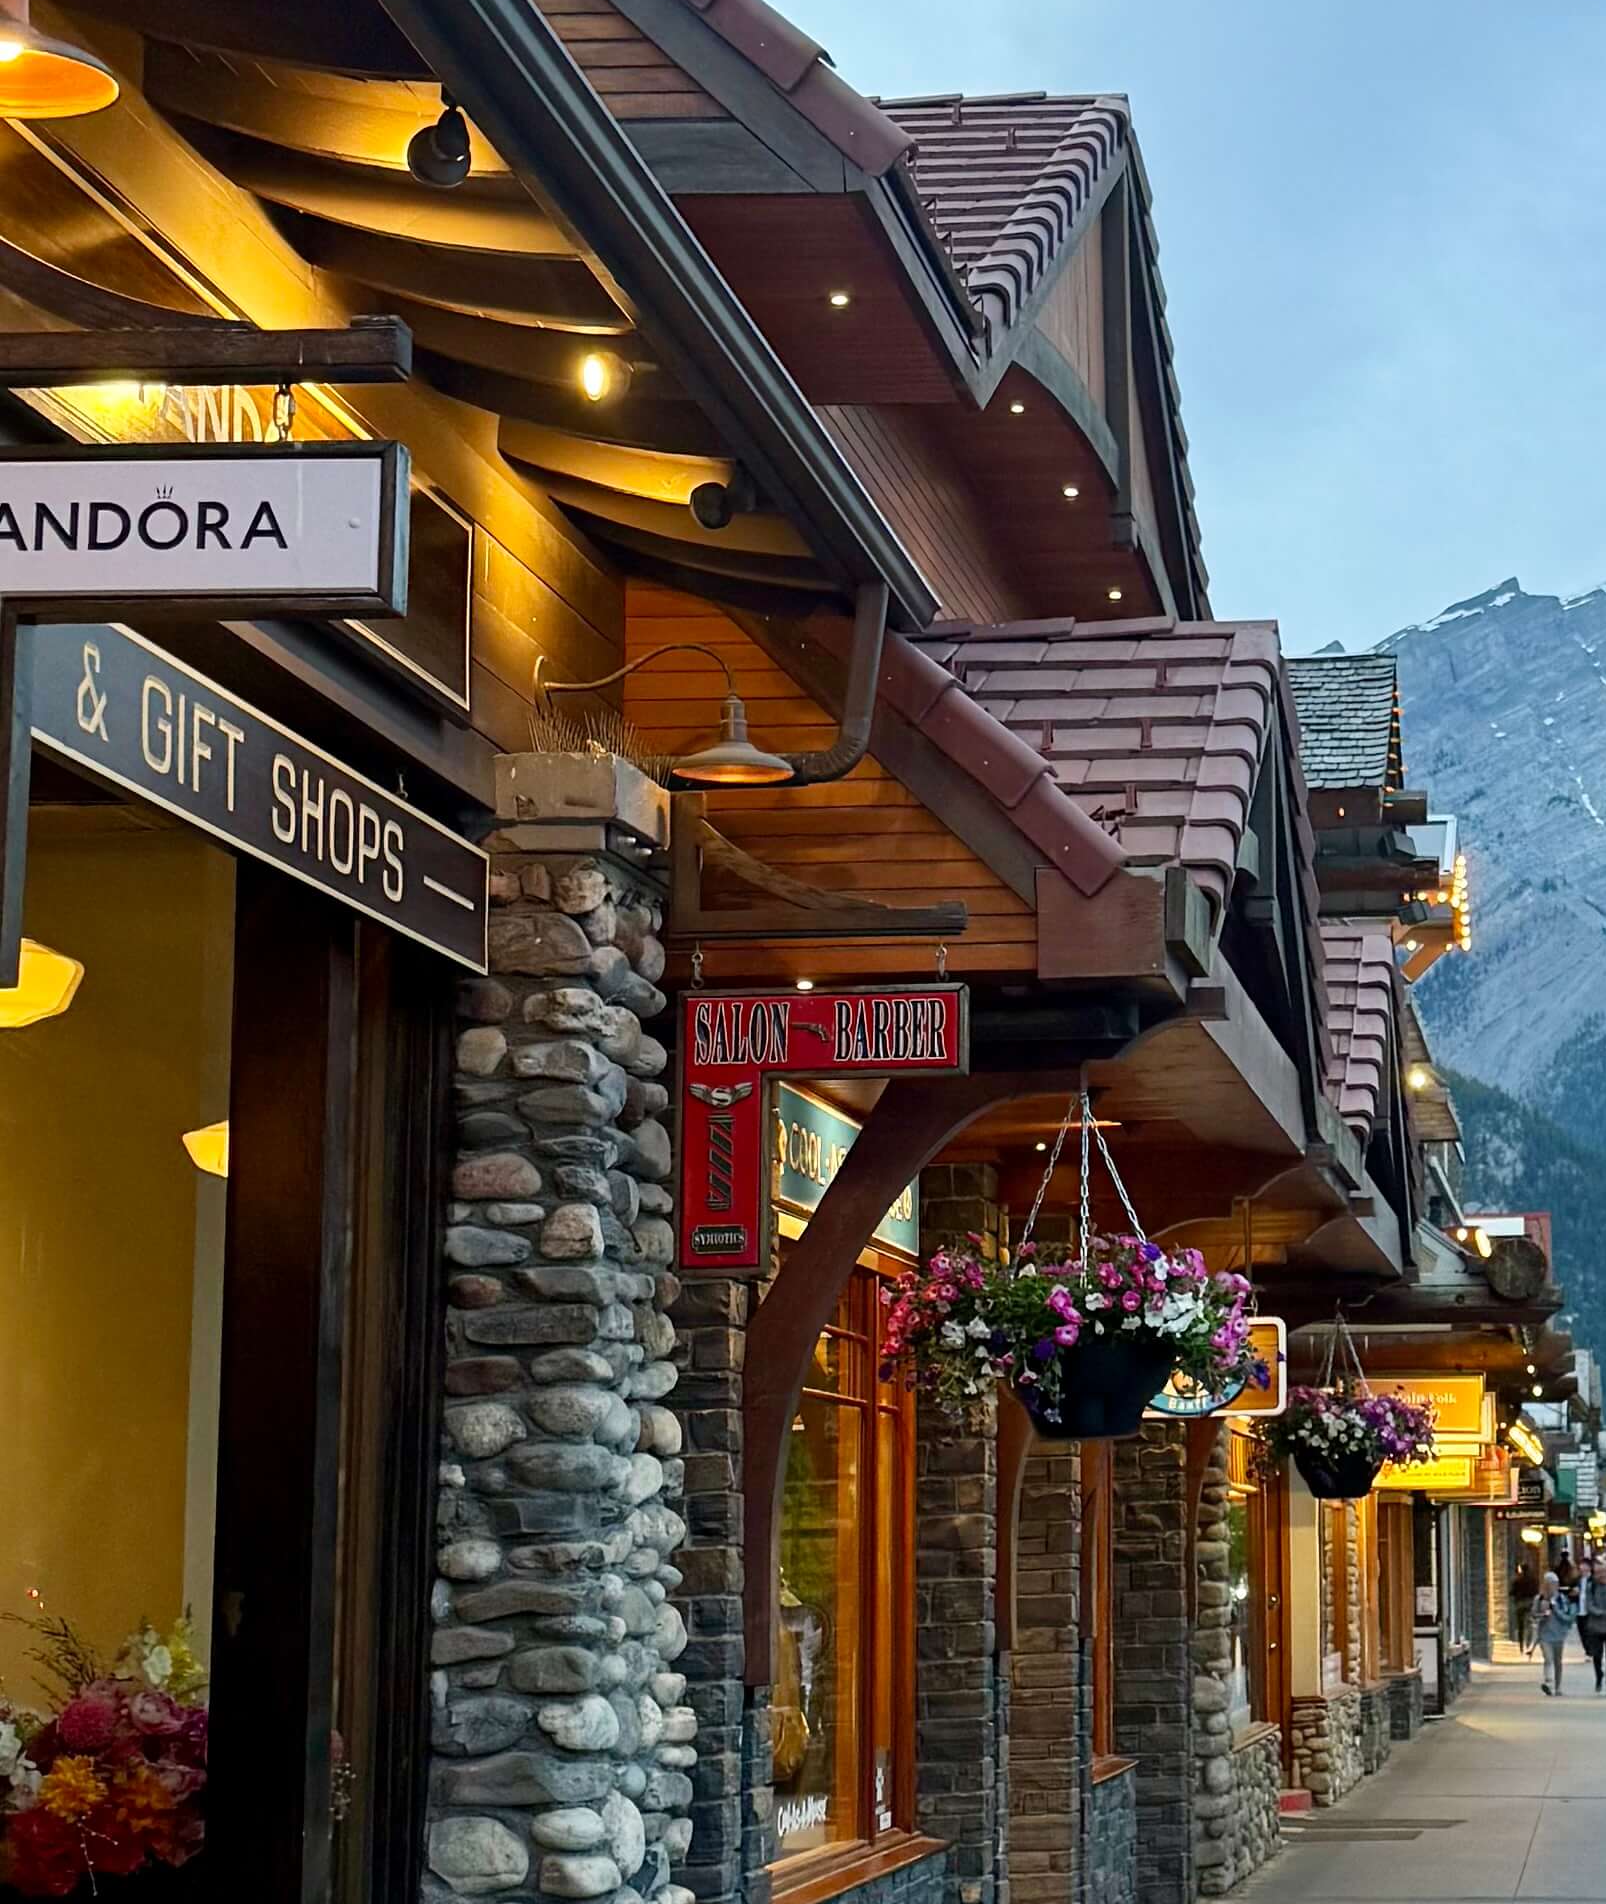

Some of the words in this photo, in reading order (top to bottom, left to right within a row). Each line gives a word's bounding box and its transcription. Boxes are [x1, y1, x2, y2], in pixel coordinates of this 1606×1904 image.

[77, 641, 110, 743] &
[142, 674, 246, 813] GIFT
[272, 753, 404, 903] SHOPS
[695, 1001, 790, 1065] SALON
[834, 999, 947, 1062] BARBER
[789, 1122, 826, 1187] COOL
